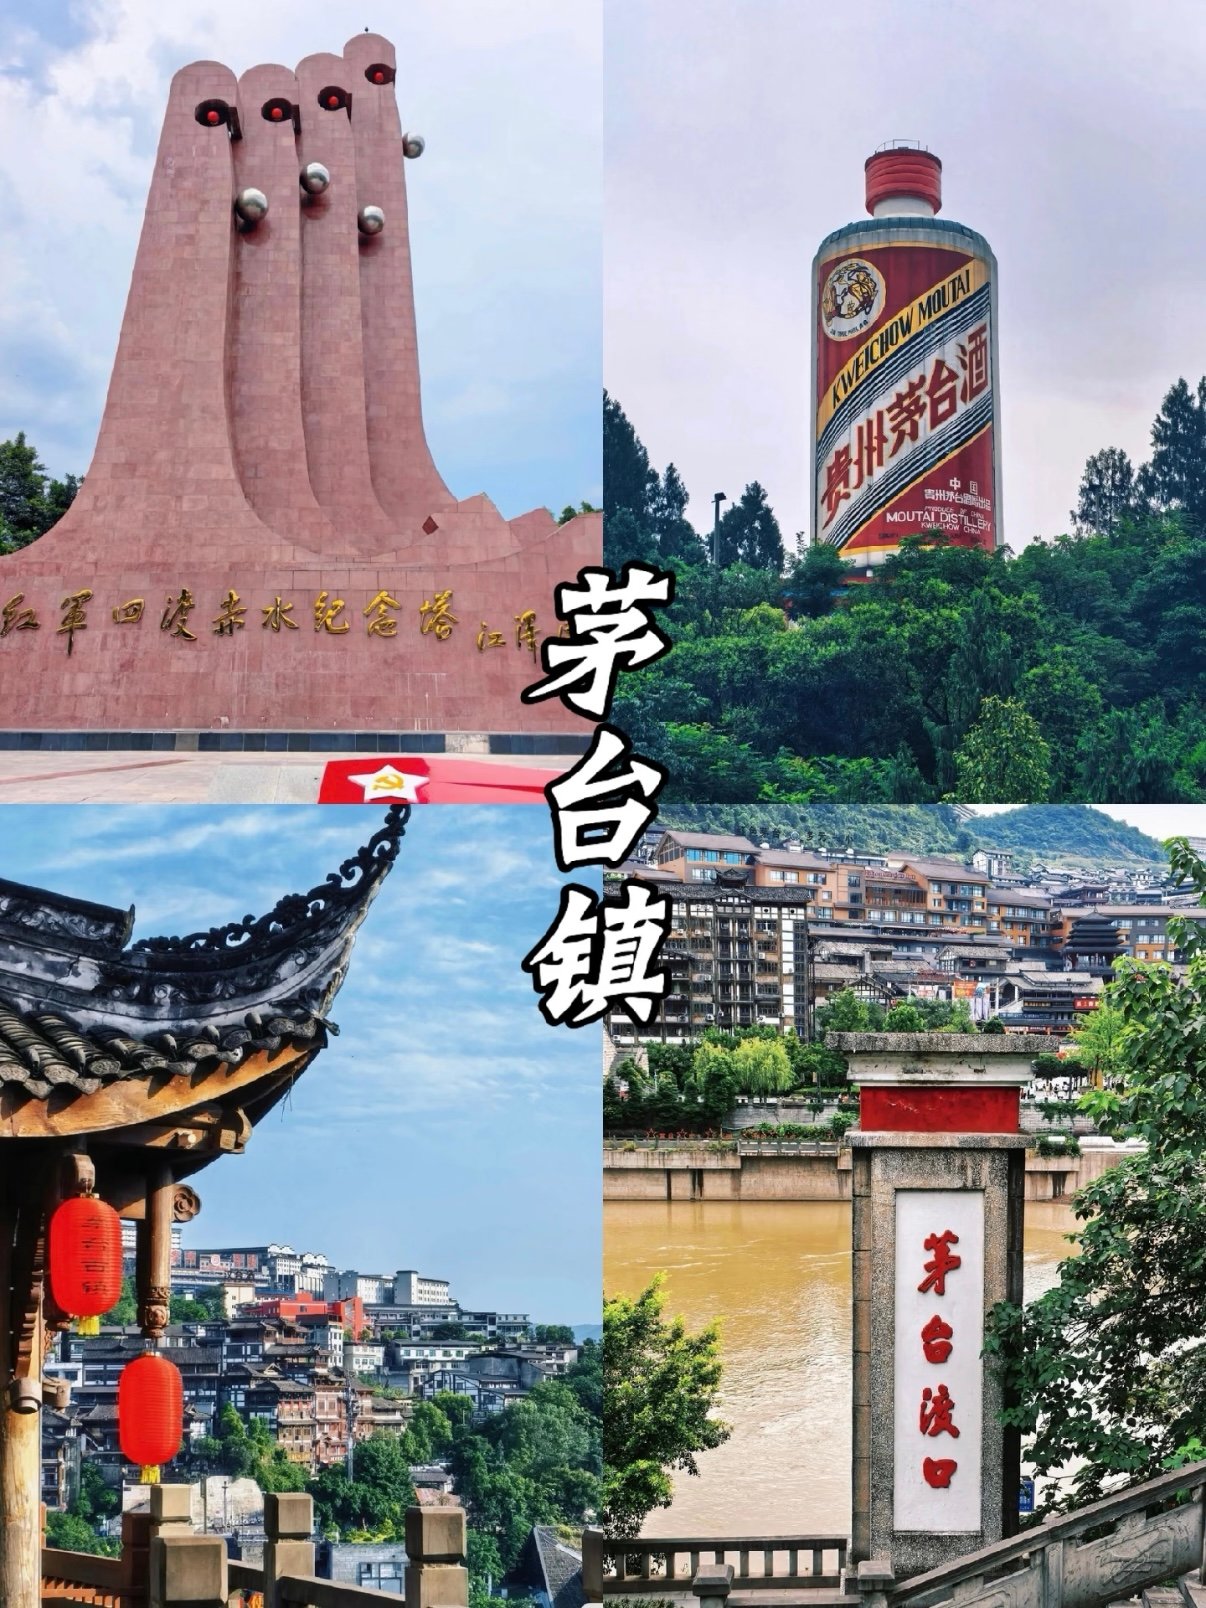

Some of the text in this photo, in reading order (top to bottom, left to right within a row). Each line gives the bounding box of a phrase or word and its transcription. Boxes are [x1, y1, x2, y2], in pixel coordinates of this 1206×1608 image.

[832, 269, 971, 405] KWEICHOW MOUTAI
[822, 322, 989, 530] 贵州茅台酒
[886, 510, 992, 532] MOUTAI DISTILLERY
[921, 521, 981, 535] KWEICHOW CHINA
[917, 1229, 961, 1489] 茅台渡口
